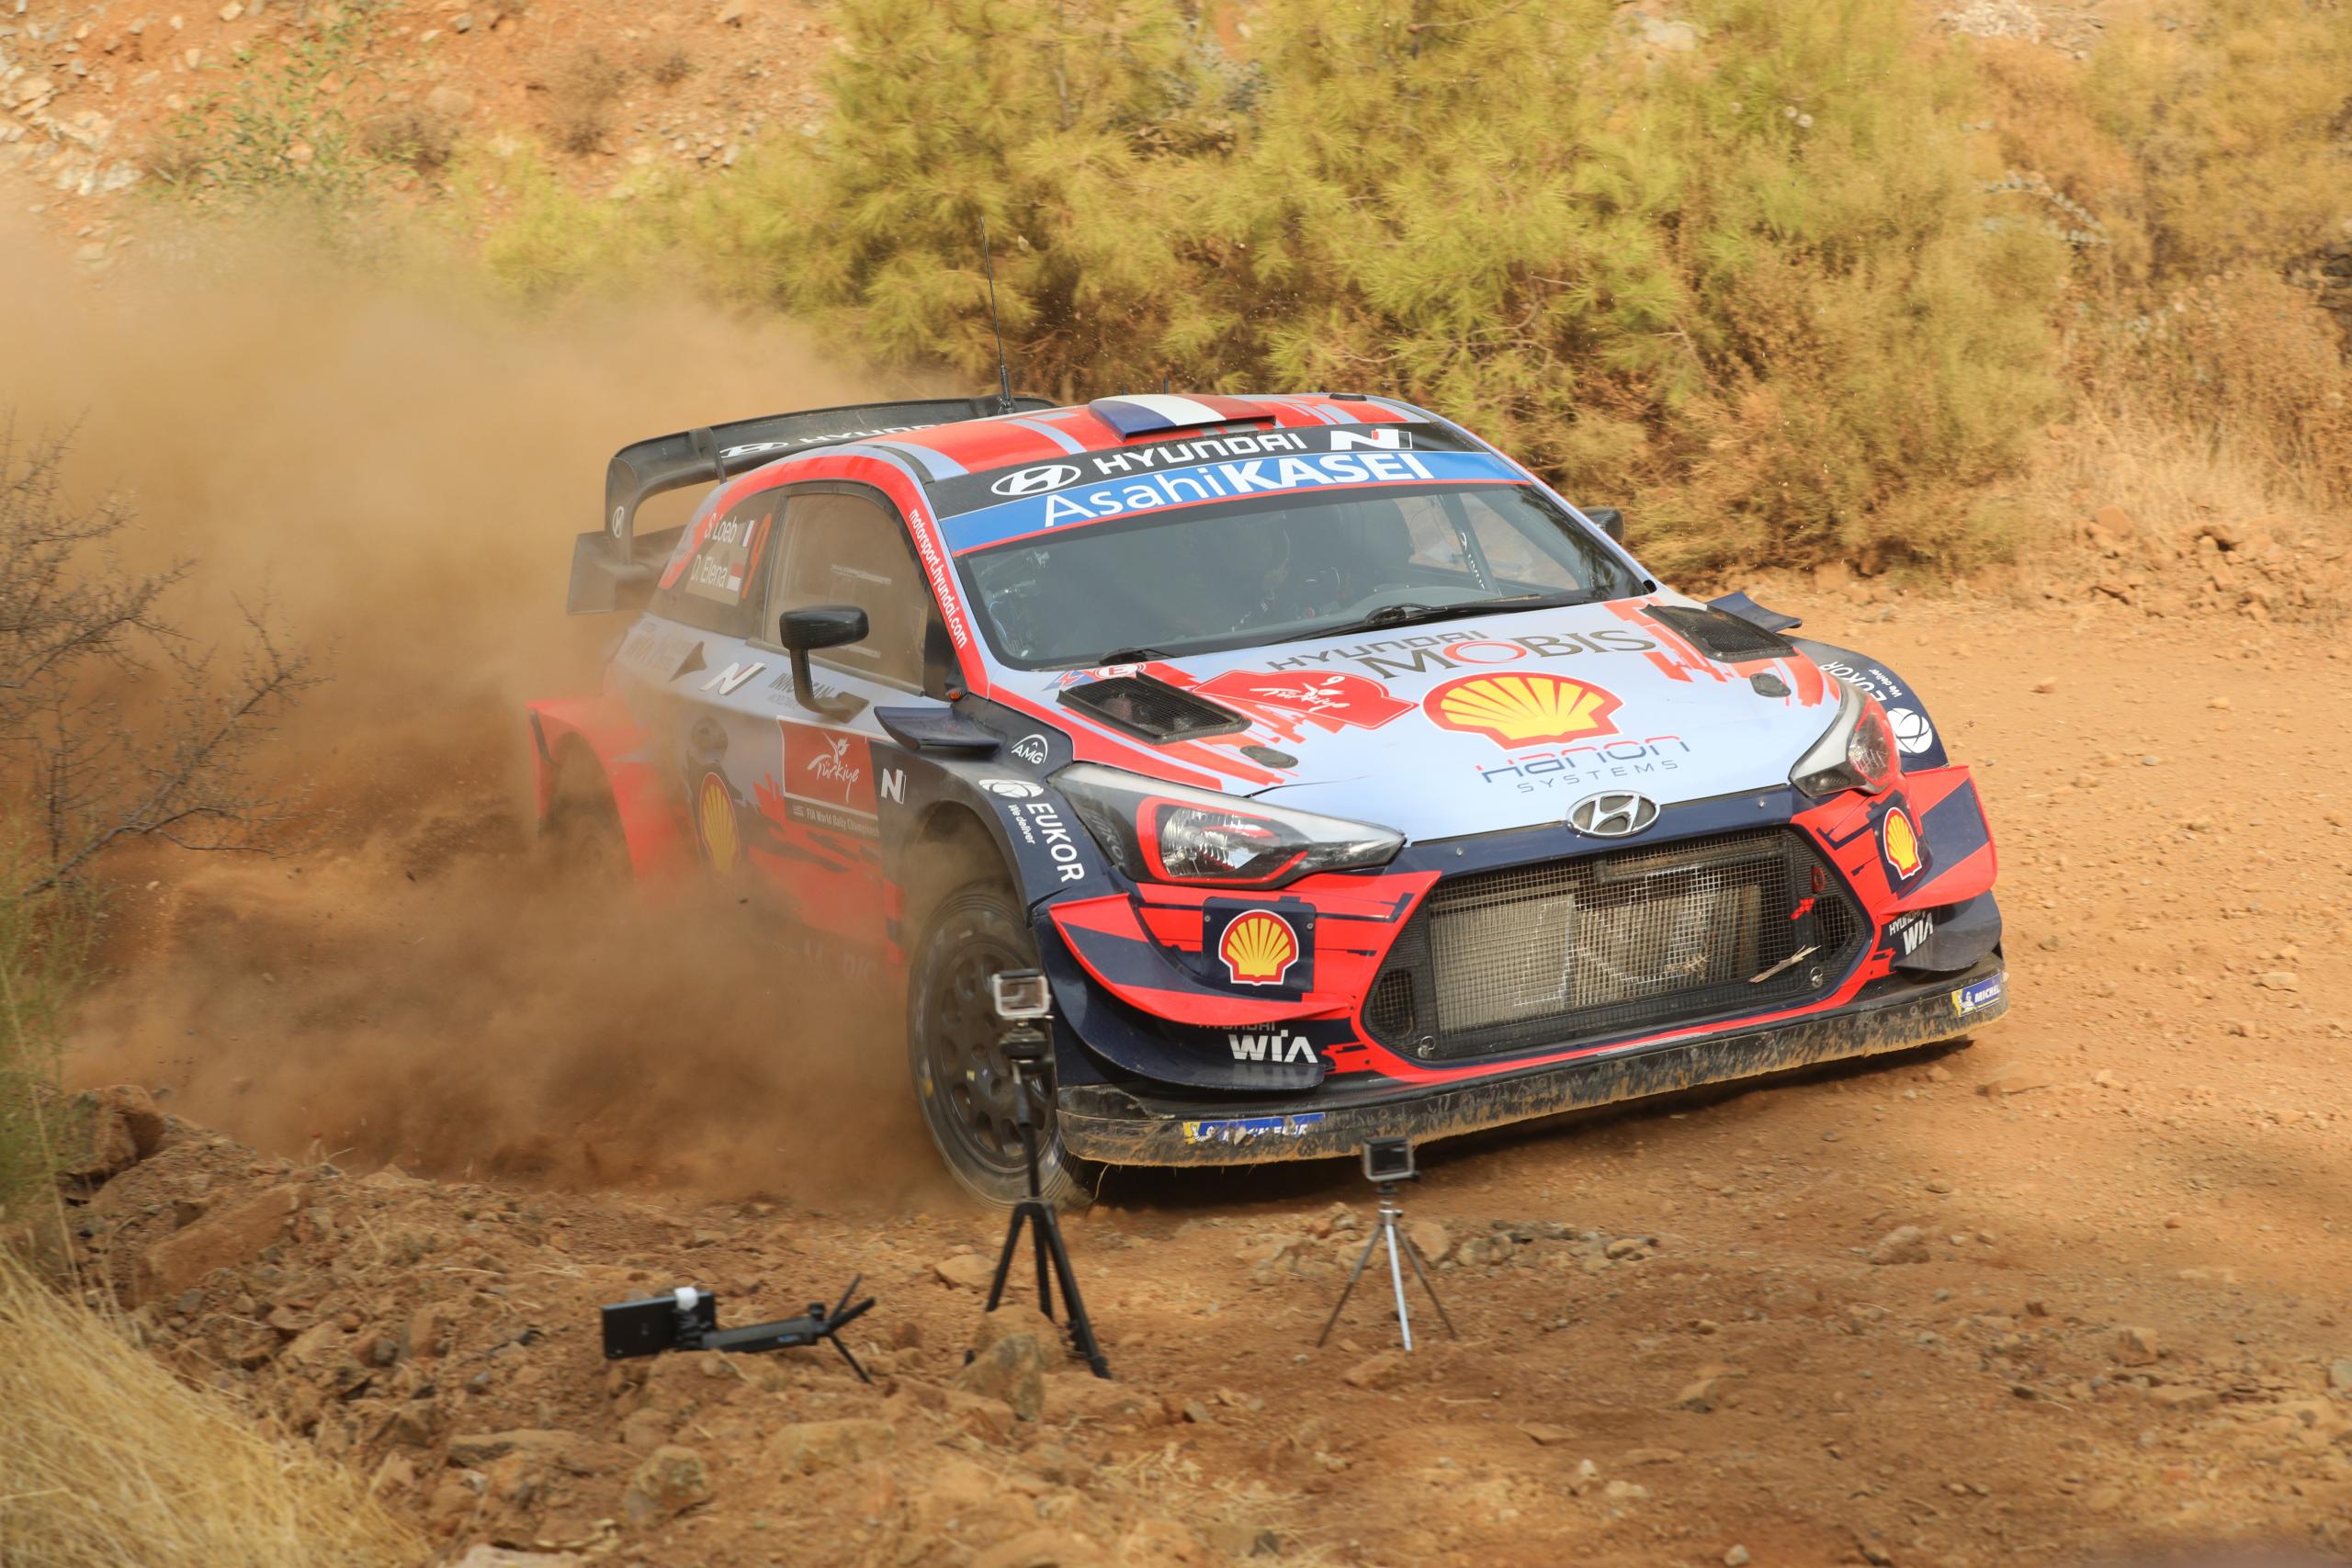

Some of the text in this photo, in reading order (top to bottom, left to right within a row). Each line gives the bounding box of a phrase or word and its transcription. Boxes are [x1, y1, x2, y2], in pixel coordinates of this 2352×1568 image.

[1092, 434, 1307, 475] HYUNDAI
[1045, 454, 1434, 528] AsahiKASEI
[713, 514, 738, 544] Loeb
[700, 556, 728, 589] Elena
[741, 513, 772, 600] 9
[909, 509, 967, 649] motorsport.hyundai.com
[1266, 630, 1489, 671] HYUNDAI
[1352, 630, 1657, 679] MOBIS
[1011, 744, 1044, 764] AMG
[808, 753, 860, 804] Türkiye
[880, 768, 907, 805] N
[1517, 760, 1678, 793] SYSTEMS
[1008, 804, 1035, 844] We deliver
[1025, 803, 1085, 882] EUKOR
[1903, 910, 1934, 955] WIA
[1974, 984, 2001, 1003] MICHEL
[1227, 1029, 1318, 1064] WIA
